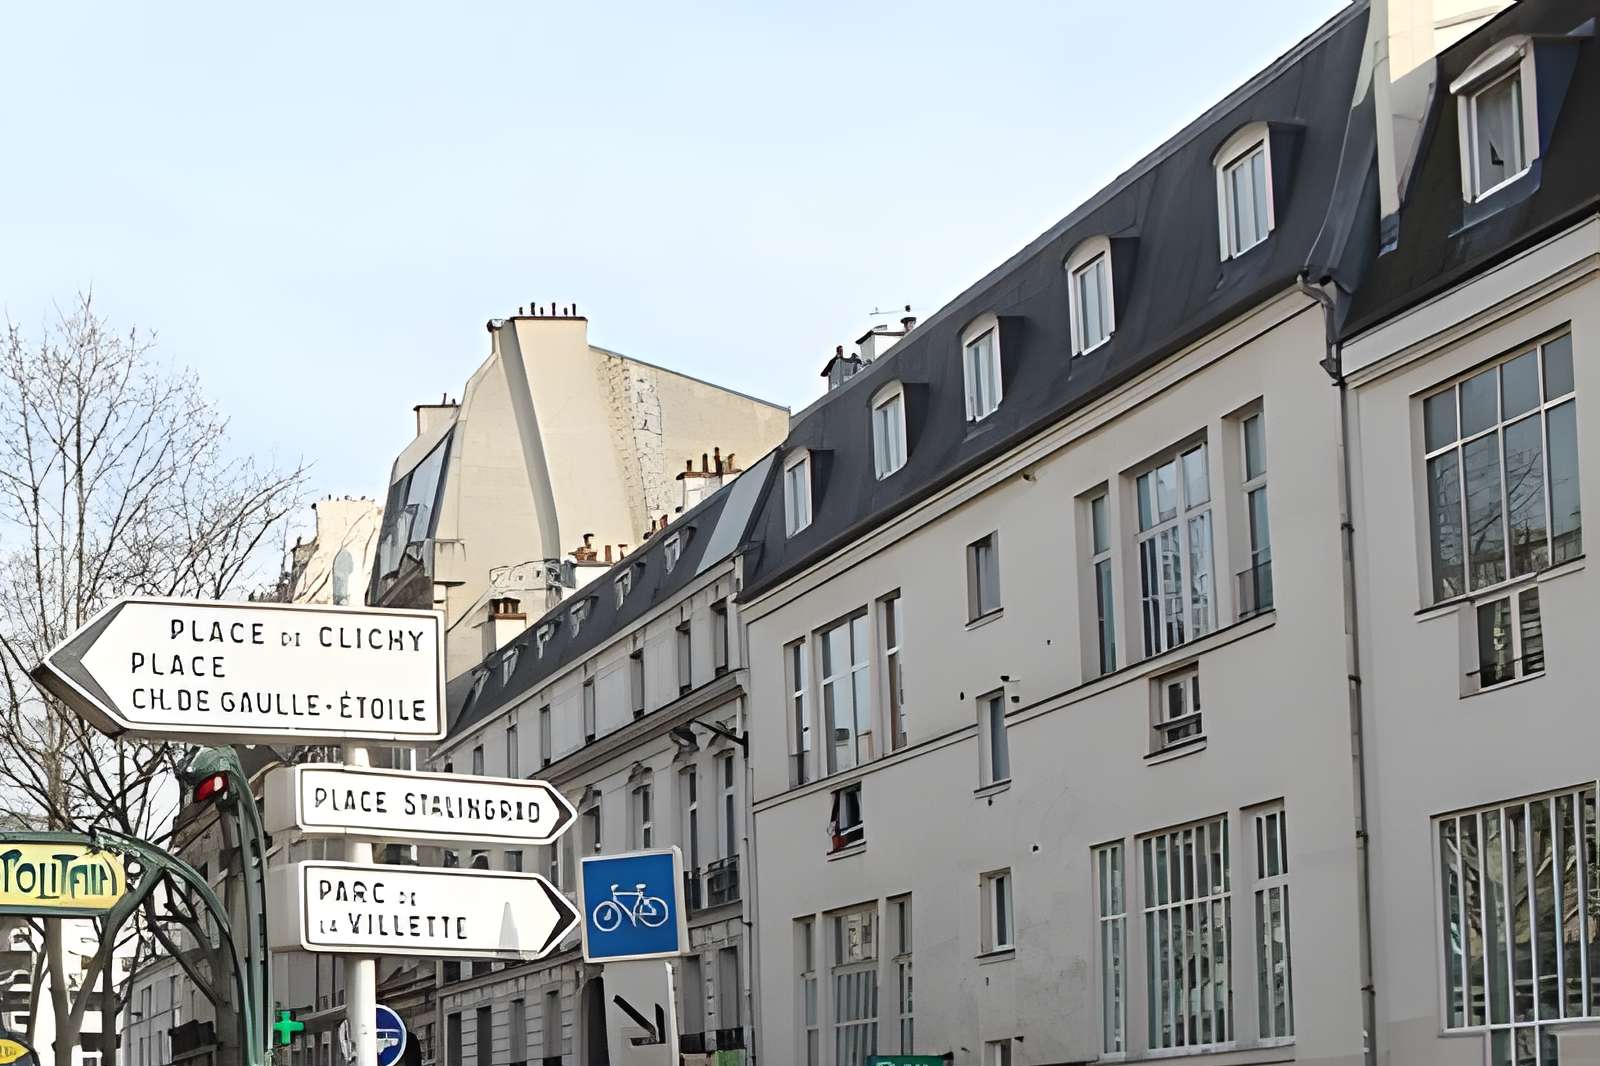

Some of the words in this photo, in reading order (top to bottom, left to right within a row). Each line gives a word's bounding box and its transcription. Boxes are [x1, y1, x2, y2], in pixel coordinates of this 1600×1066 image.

[170, 618, 265, 645] PLACE
[319, 626, 424, 652] CLICHY
[131, 651, 226, 678] PLACE
[314, 787, 388, 814] PLACE
[319, 879, 385, 904] PARC
[347, 912, 468, 940] VILLETTE
